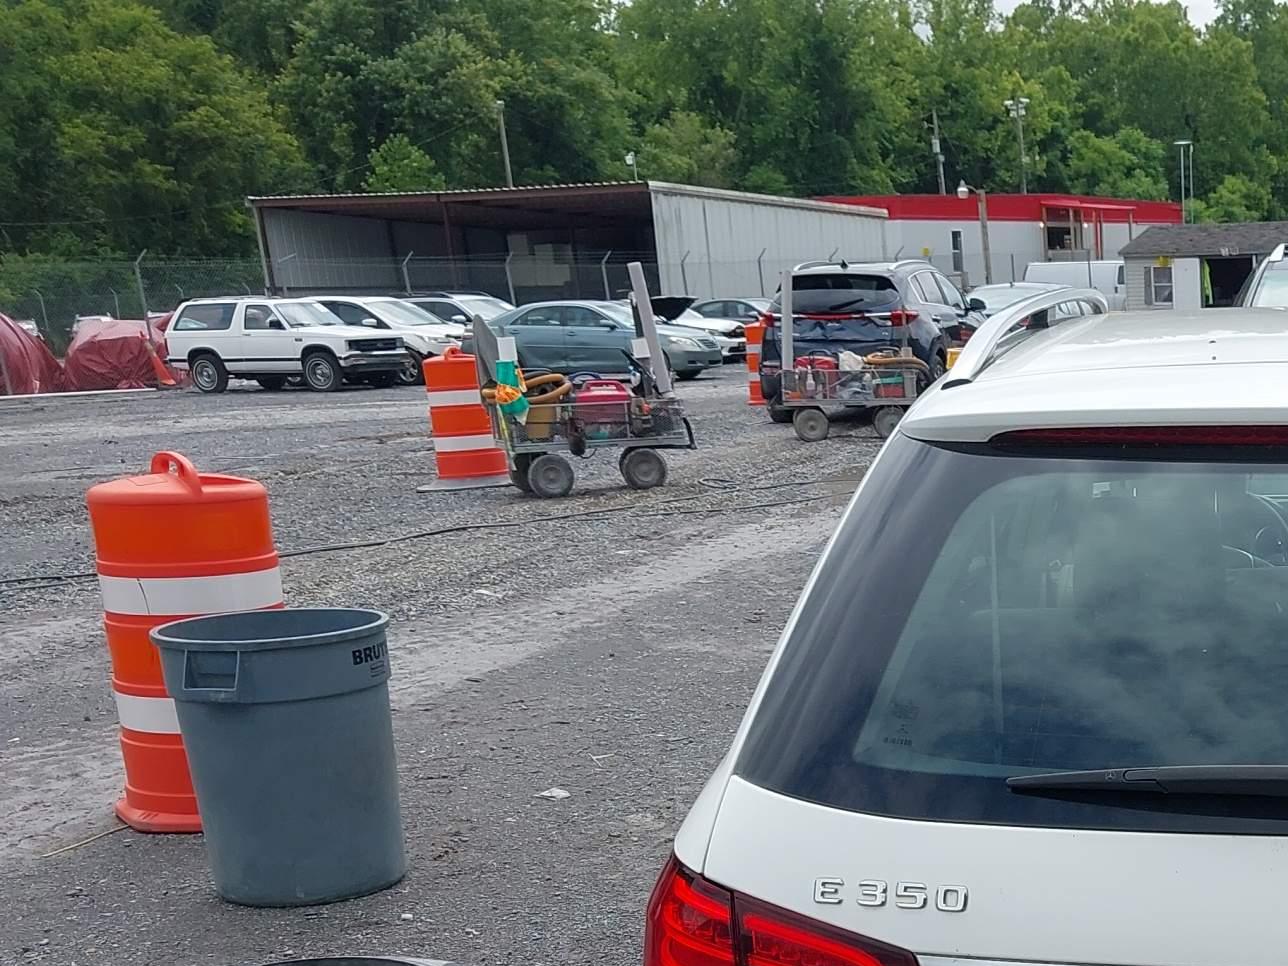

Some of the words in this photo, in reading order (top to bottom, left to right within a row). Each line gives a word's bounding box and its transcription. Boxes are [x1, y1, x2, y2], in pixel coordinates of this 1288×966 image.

[352, 643, 387, 666] BRUT
[813, 877, 844, 904] E
[857, 879, 969, 912] 350
